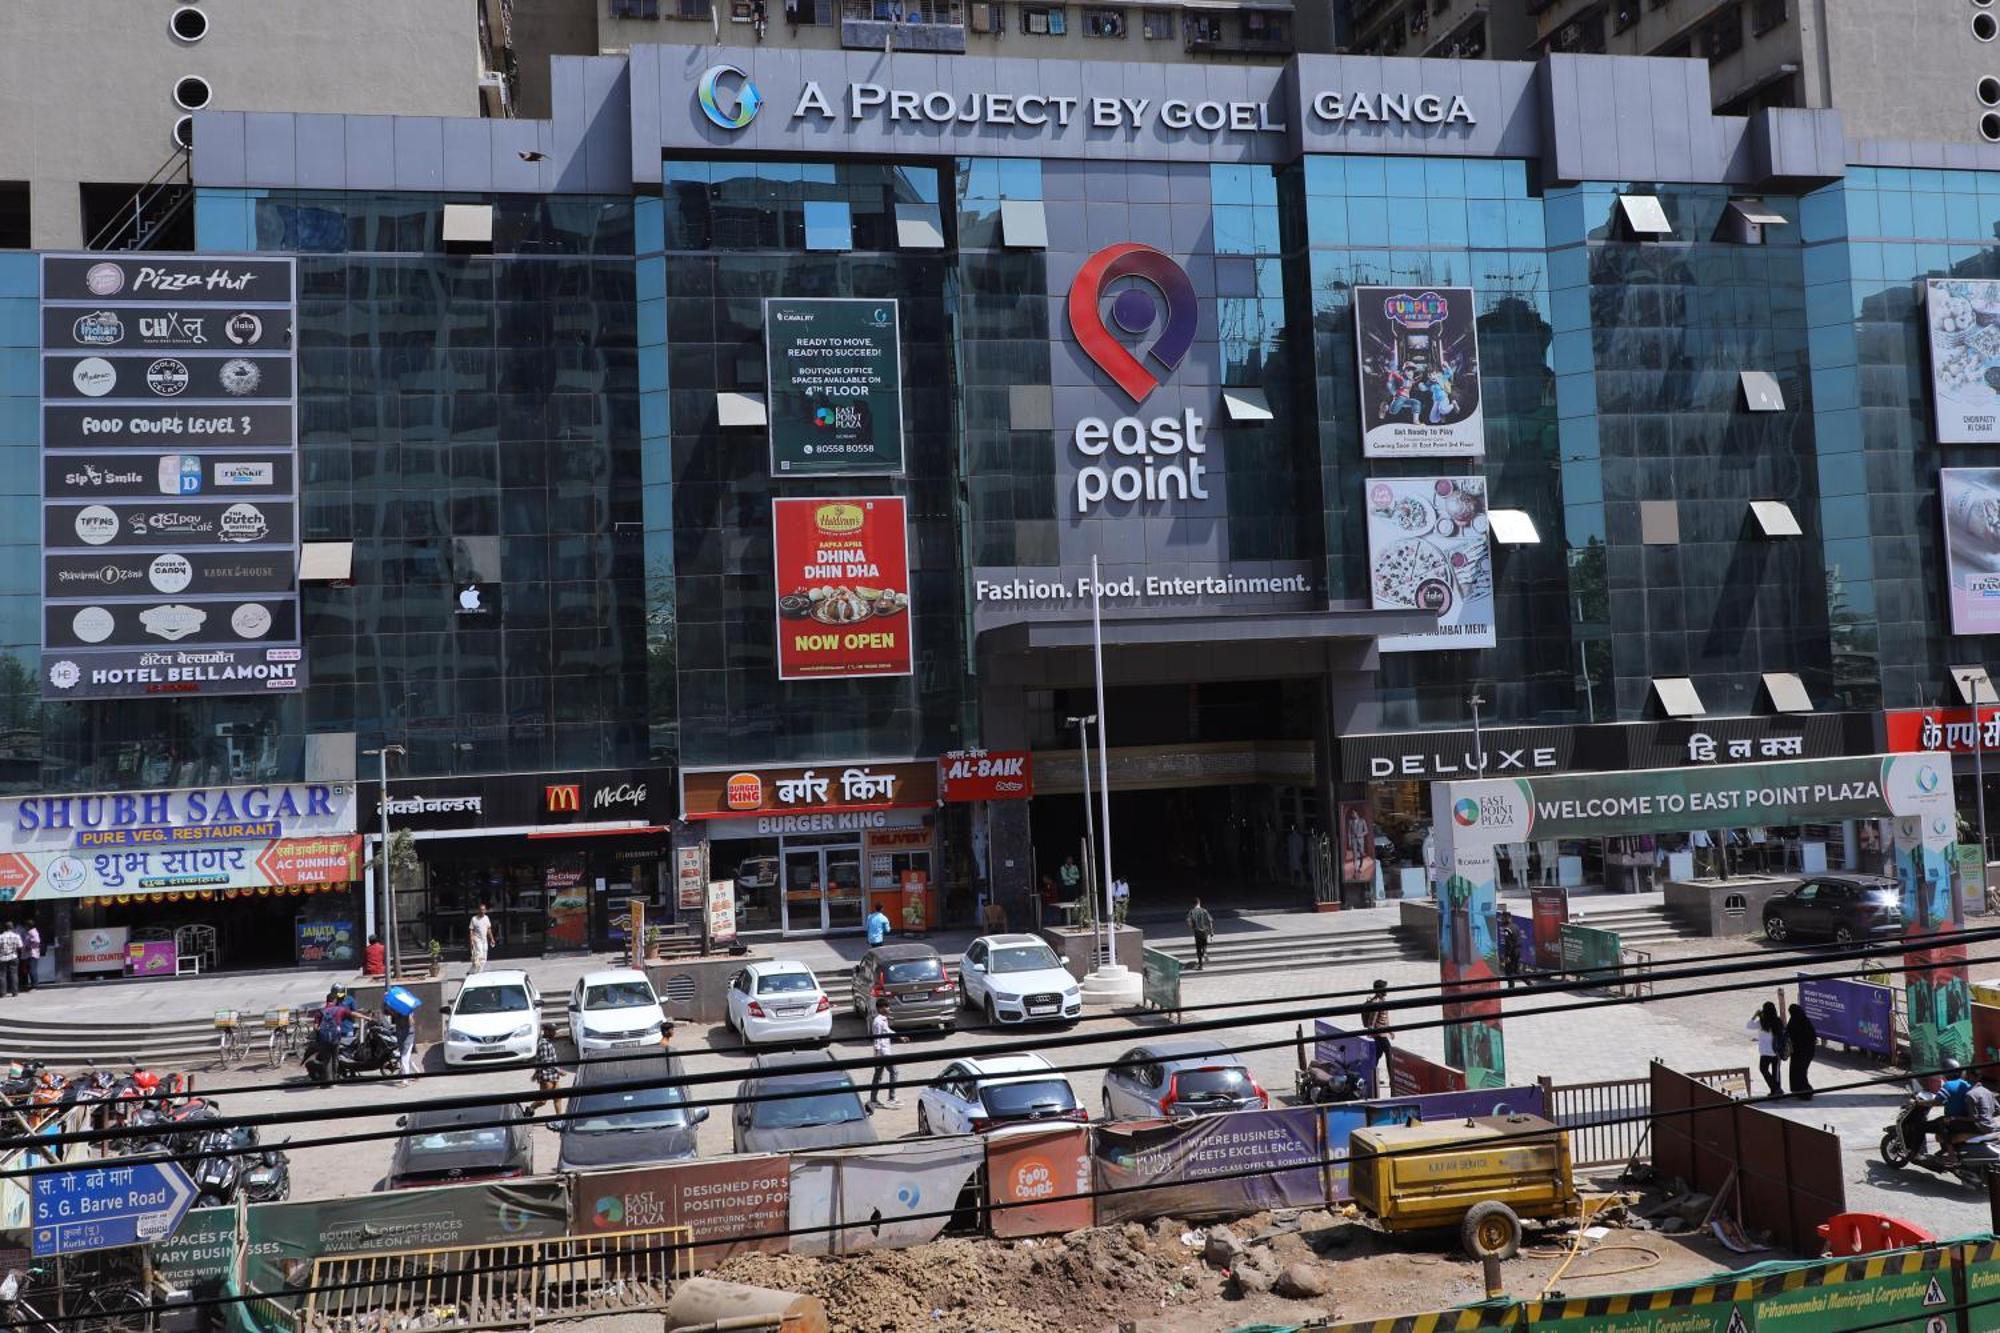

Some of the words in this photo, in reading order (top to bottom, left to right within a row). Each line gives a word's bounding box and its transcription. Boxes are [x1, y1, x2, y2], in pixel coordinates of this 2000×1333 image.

[793, 83, 837, 119] A
[852, 83, 1076, 127] PROJECT
[1092, 97, 1152, 130] BY
[1161, 99, 1288, 135] GOEL
[1313, 90, 1478, 126] GANGA
[133, 267, 202, 291] Pizza
[202, 268, 259, 291] Hut
[796, 338, 828, 347] READY
[829, 338, 842, 346] TO
[787, 348, 819, 358] READY
[821, 348, 834, 357] TO
[799, 367, 842, 376] BOUTIQUE
[843, 367, 874, 375] OFFICE
[791, 377, 823, 385] SPACES
[823, 376, 867, 385] AVAILABLE
[825, 386, 869, 396] FLOOR
[835, 407, 856, 415] EAST
[835, 414, 863, 422] POINT
[82, 417, 123, 435] FOOD
[188, 417, 235, 435] LEVEL
[242, 416, 252, 435] 3
[835, 421, 862, 429] PLAZA
[1075, 407, 1207, 456] east
[65, 473, 89, 487] Sip
[105, 470, 144, 485] Smile
[1077, 456, 1209, 513] point
[223, 513, 262, 525] Dutch
[816, 549, 867, 564] DHINA
[154, 566, 187, 576] CANDY
[804, 565, 842, 580] DHIN
[846, 565, 880, 578] DHA
[976, 578, 1073, 601] Fashion.
[1146, 572, 1312, 596] Entertainment.
[795, 634, 840, 652] NOW
[844, 632, 895, 650] OPEN
[92, 666, 164, 685] HOTEL
[167, 663, 297, 682] BELLAMONT
[948, 757, 1025, 779] AL-BAIK
[1371, 747, 1557, 777] DELUXE
[729, 784, 760, 793] BURGER
[775, 770, 830, 804] बर्गर
[840, 768, 896, 801] किंग
[729, 791, 760, 802] KING
[1481, 795, 1505, 806] EAST
[1538, 799, 1653, 820] WELCOME
[1659, 795, 1685, 813] TO
[1690, 791, 1741, 811] EAST
[1746, 786, 1810, 807] POINT
[1813, 780, 1880, 800] PLAZA
[17, 790, 172, 834] SHUBH
[185, 784, 337, 824] SAGAR
[1481, 804, 1513, 816] POINT
[757, 813, 836, 835] BURGER
[837, 811, 886, 830] KING
[1481, 815, 1514, 826] PLAZA
[82, 831, 126, 847] PURE
[132, 829, 168, 843] VEG.
[172, 822, 276, 841] RESTAURANT
[870, 832, 928, 846] DELIVERY
[94, 850, 150, 888] शुभ
[161, 846, 246, 875] सागर
[275, 859, 293, 870] AC
[296, 856, 347, 869] DINNING
[298, 871, 326, 881] HALL
[1187, 1135, 1230, 1149] WHERE
[1232, 1128, 1288, 1144] BUSINESS
[1188, 1149, 1227, 1163] MEETS
[1229, 1141, 1302, 1157] EXCELLENCE
[1190, 1164, 1243, 1177] WORLD-CLASS
[1278, 1157, 1307, 1168] ROBUST
[1018, 1168, 1048, 1185] FOOD
[683, 1182, 750, 1198] DESIGNED
[752, 1178, 780, 1190] FOR
[38, 1202, 54, 1219] S.
[58, 1200, 76, 1216] G.
[81, 1197, 123, 1214] Barve
[128, 1187, 166, 1207] Road
[625, 1191, 655, 1204] EAST
[683, 1194, 764, 1213] POSITIONED
[625, 1201, 666, 1216] POINT
[422, 1219, 464, 1231] SPACES
[625, 1214, 666, 1228] PLAZA
[384, 1237, 403, 1249] ON
[420, 1231, 458, 1244] FLOOR
[1827, 1288, 1875, 1312] Municipal
[1875, 1281, 1928, 1306] Corporation
[1655, 1312, 1713, 1333] Corporation
